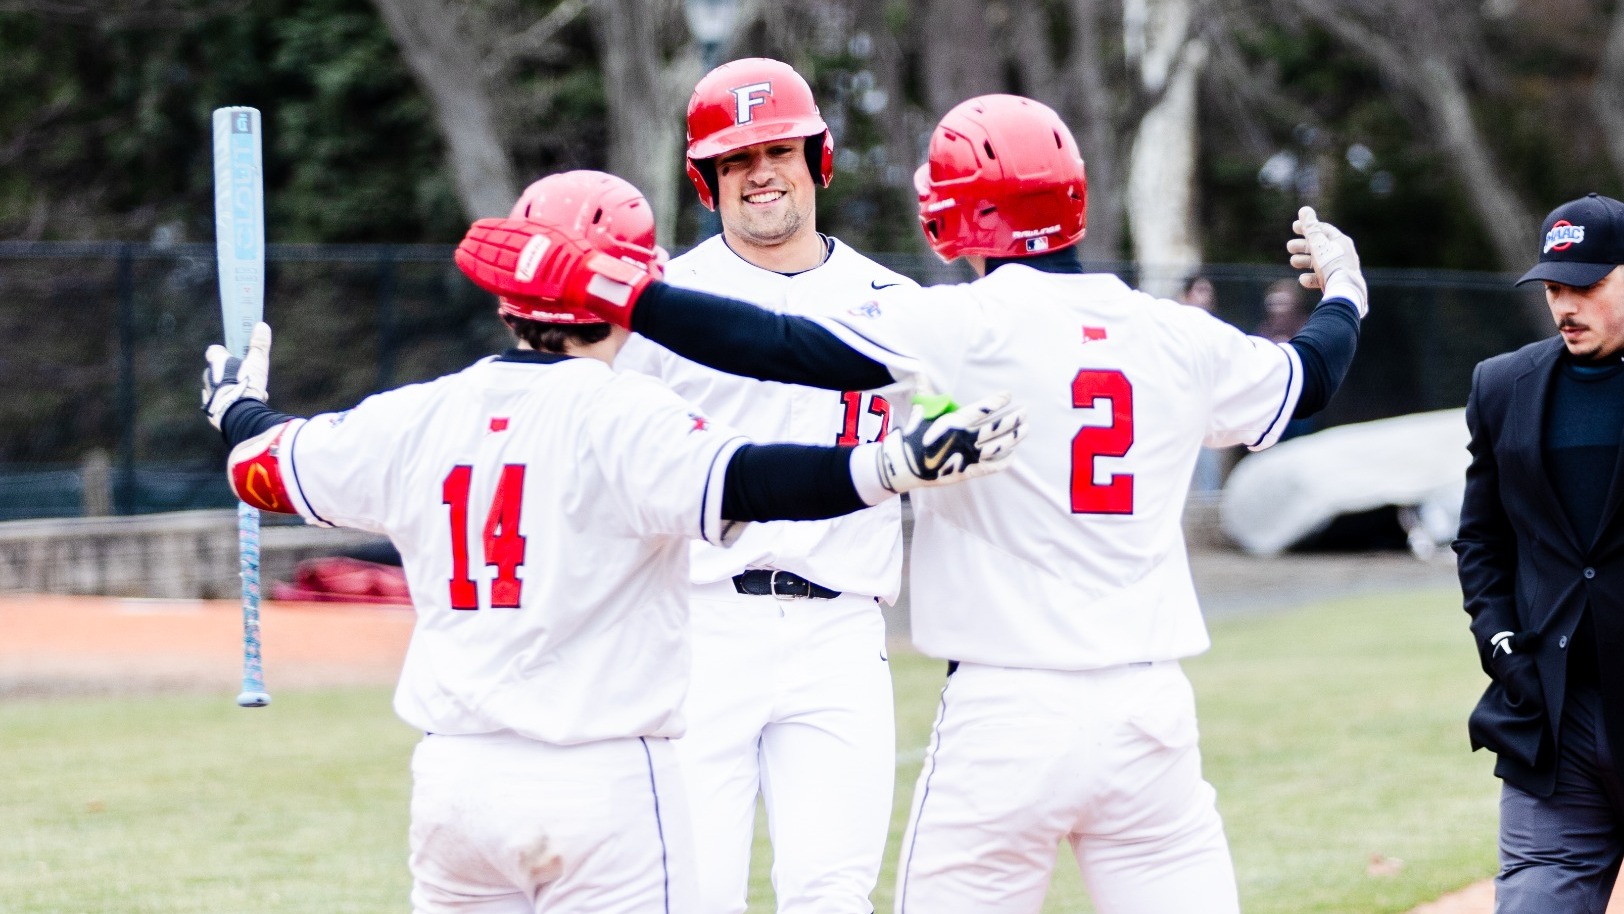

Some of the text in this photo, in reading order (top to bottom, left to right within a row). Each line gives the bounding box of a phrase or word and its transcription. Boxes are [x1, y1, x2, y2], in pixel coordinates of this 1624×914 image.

[727, 81, 773, 127] F
[1071, 368, 1134, 515] 2
[442, 463, 527, 610] 14
